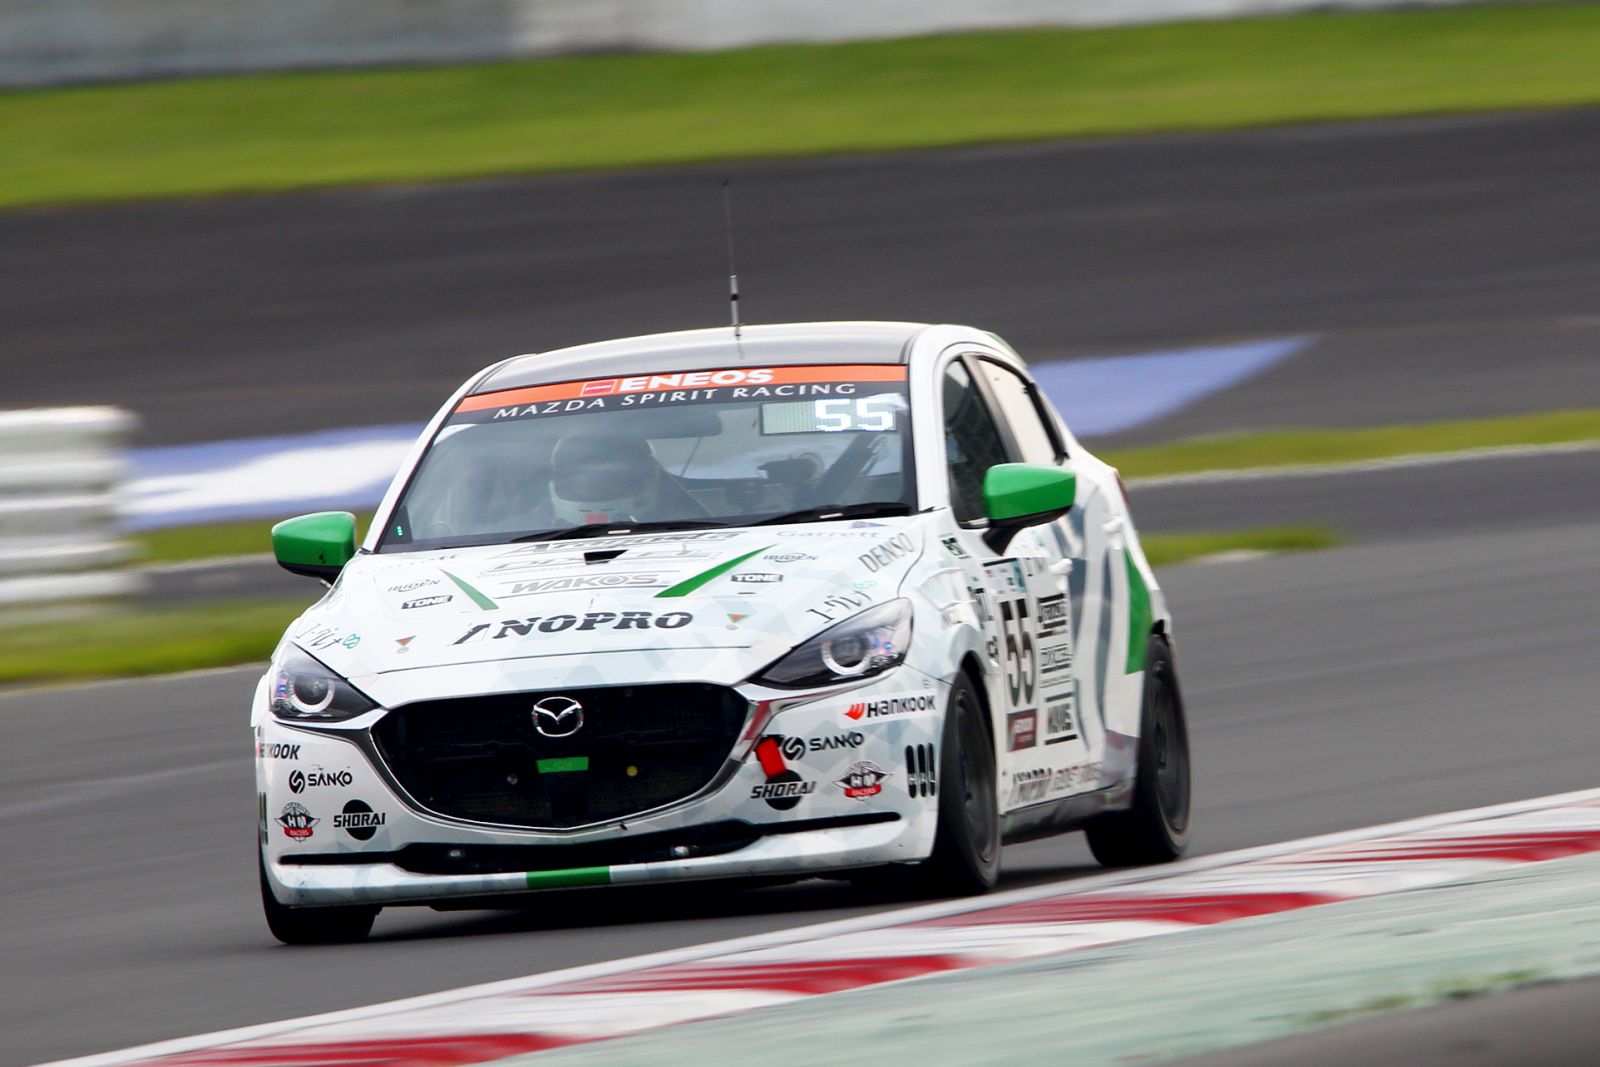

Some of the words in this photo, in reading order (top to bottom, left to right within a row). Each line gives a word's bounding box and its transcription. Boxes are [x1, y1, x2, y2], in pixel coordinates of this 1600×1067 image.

[619, 369, 774, 392] ENEOS
[493, 397, 606, 420] MAZDA
[620, 388, 718, 407] SPIRIT
[732, 383, 856, 399] RACING
[814, 398, 895, 432] 55
[858, 531, 915, 574] DENSO
[735, 574, 780, 582] TONE
[407, 596, 449, 609] TONE
[999, 598, 1035, 707] 55
[809, 731, 865, 752] SANKO
[307, 770, 353, 787] SANKO
[750, 781, 817, 799] SHORAI
[333, 812, 386, 828] SHORAI
